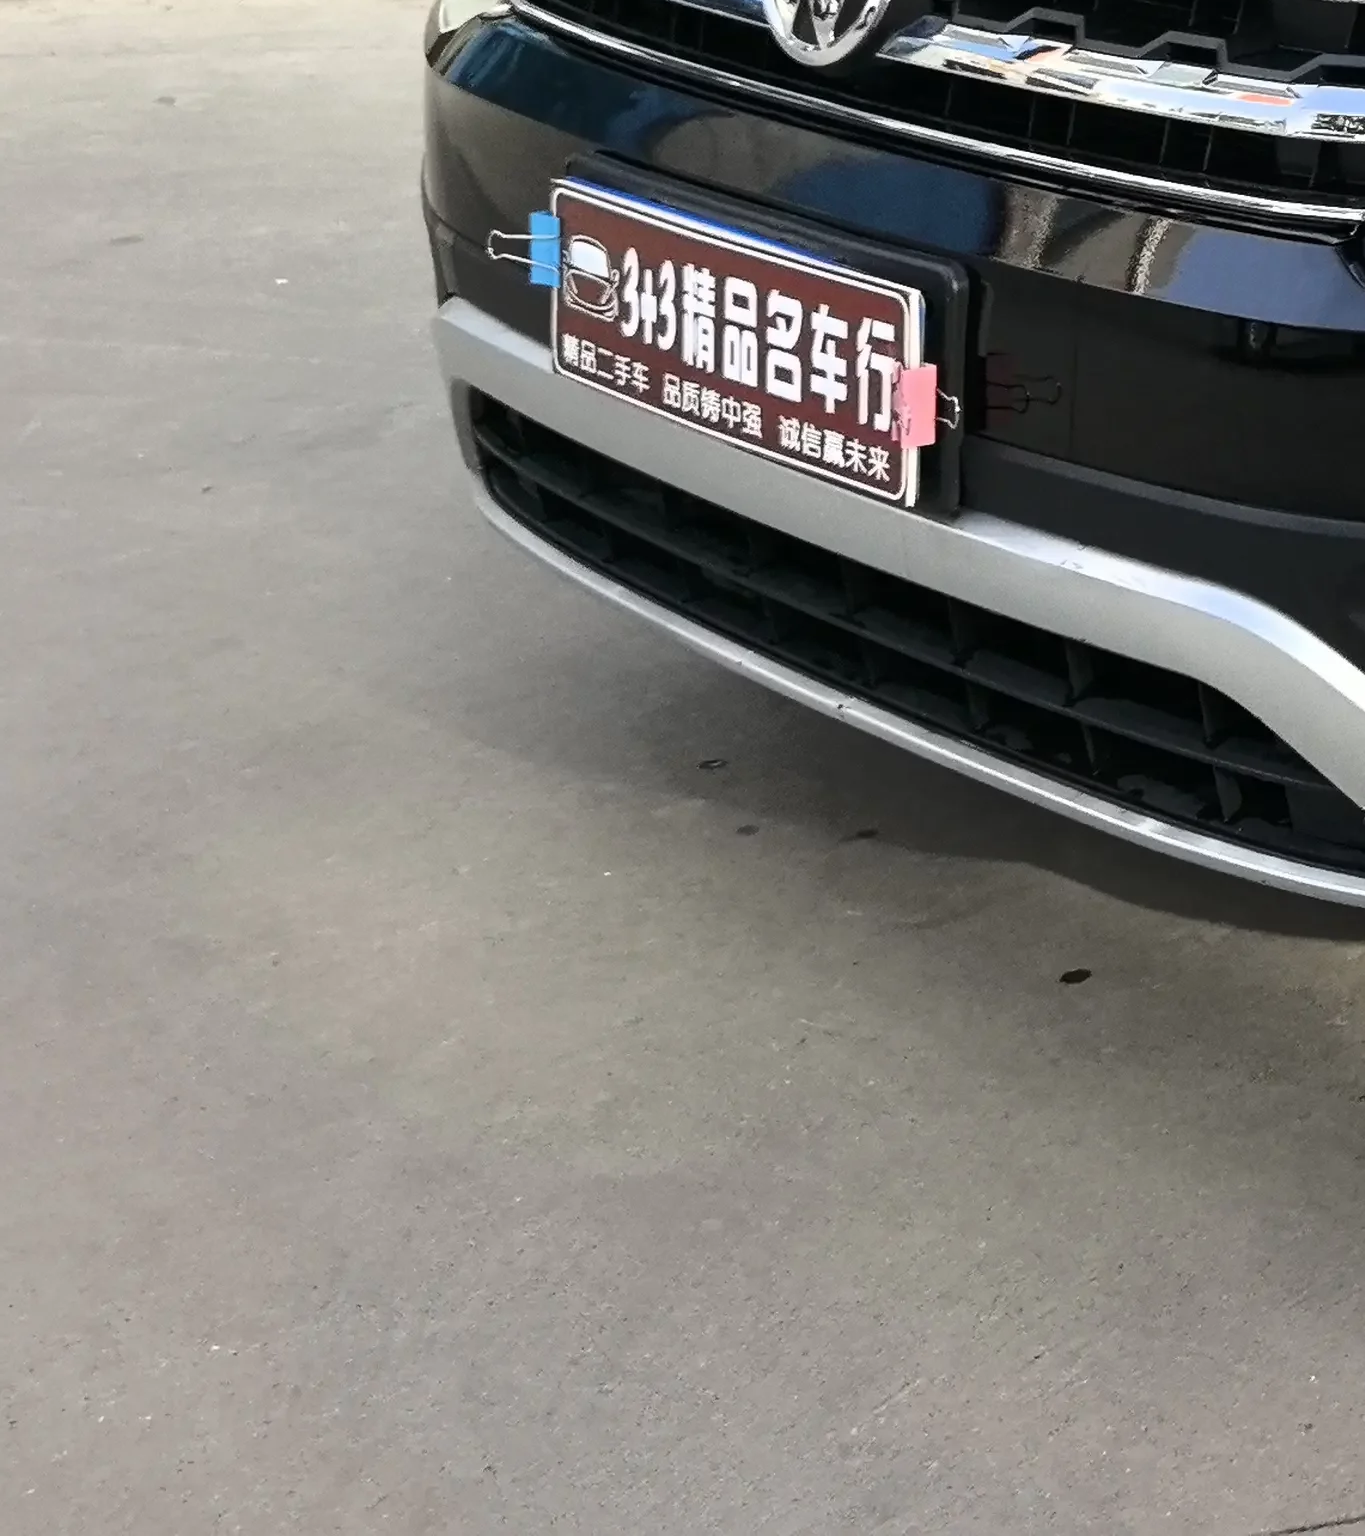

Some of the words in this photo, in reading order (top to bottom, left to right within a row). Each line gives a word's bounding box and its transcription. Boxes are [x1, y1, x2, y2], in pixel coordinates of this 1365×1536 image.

[563, 333, 650, 393] 精品二手车
[777, 415, 891, 482] 诚信赢未来
